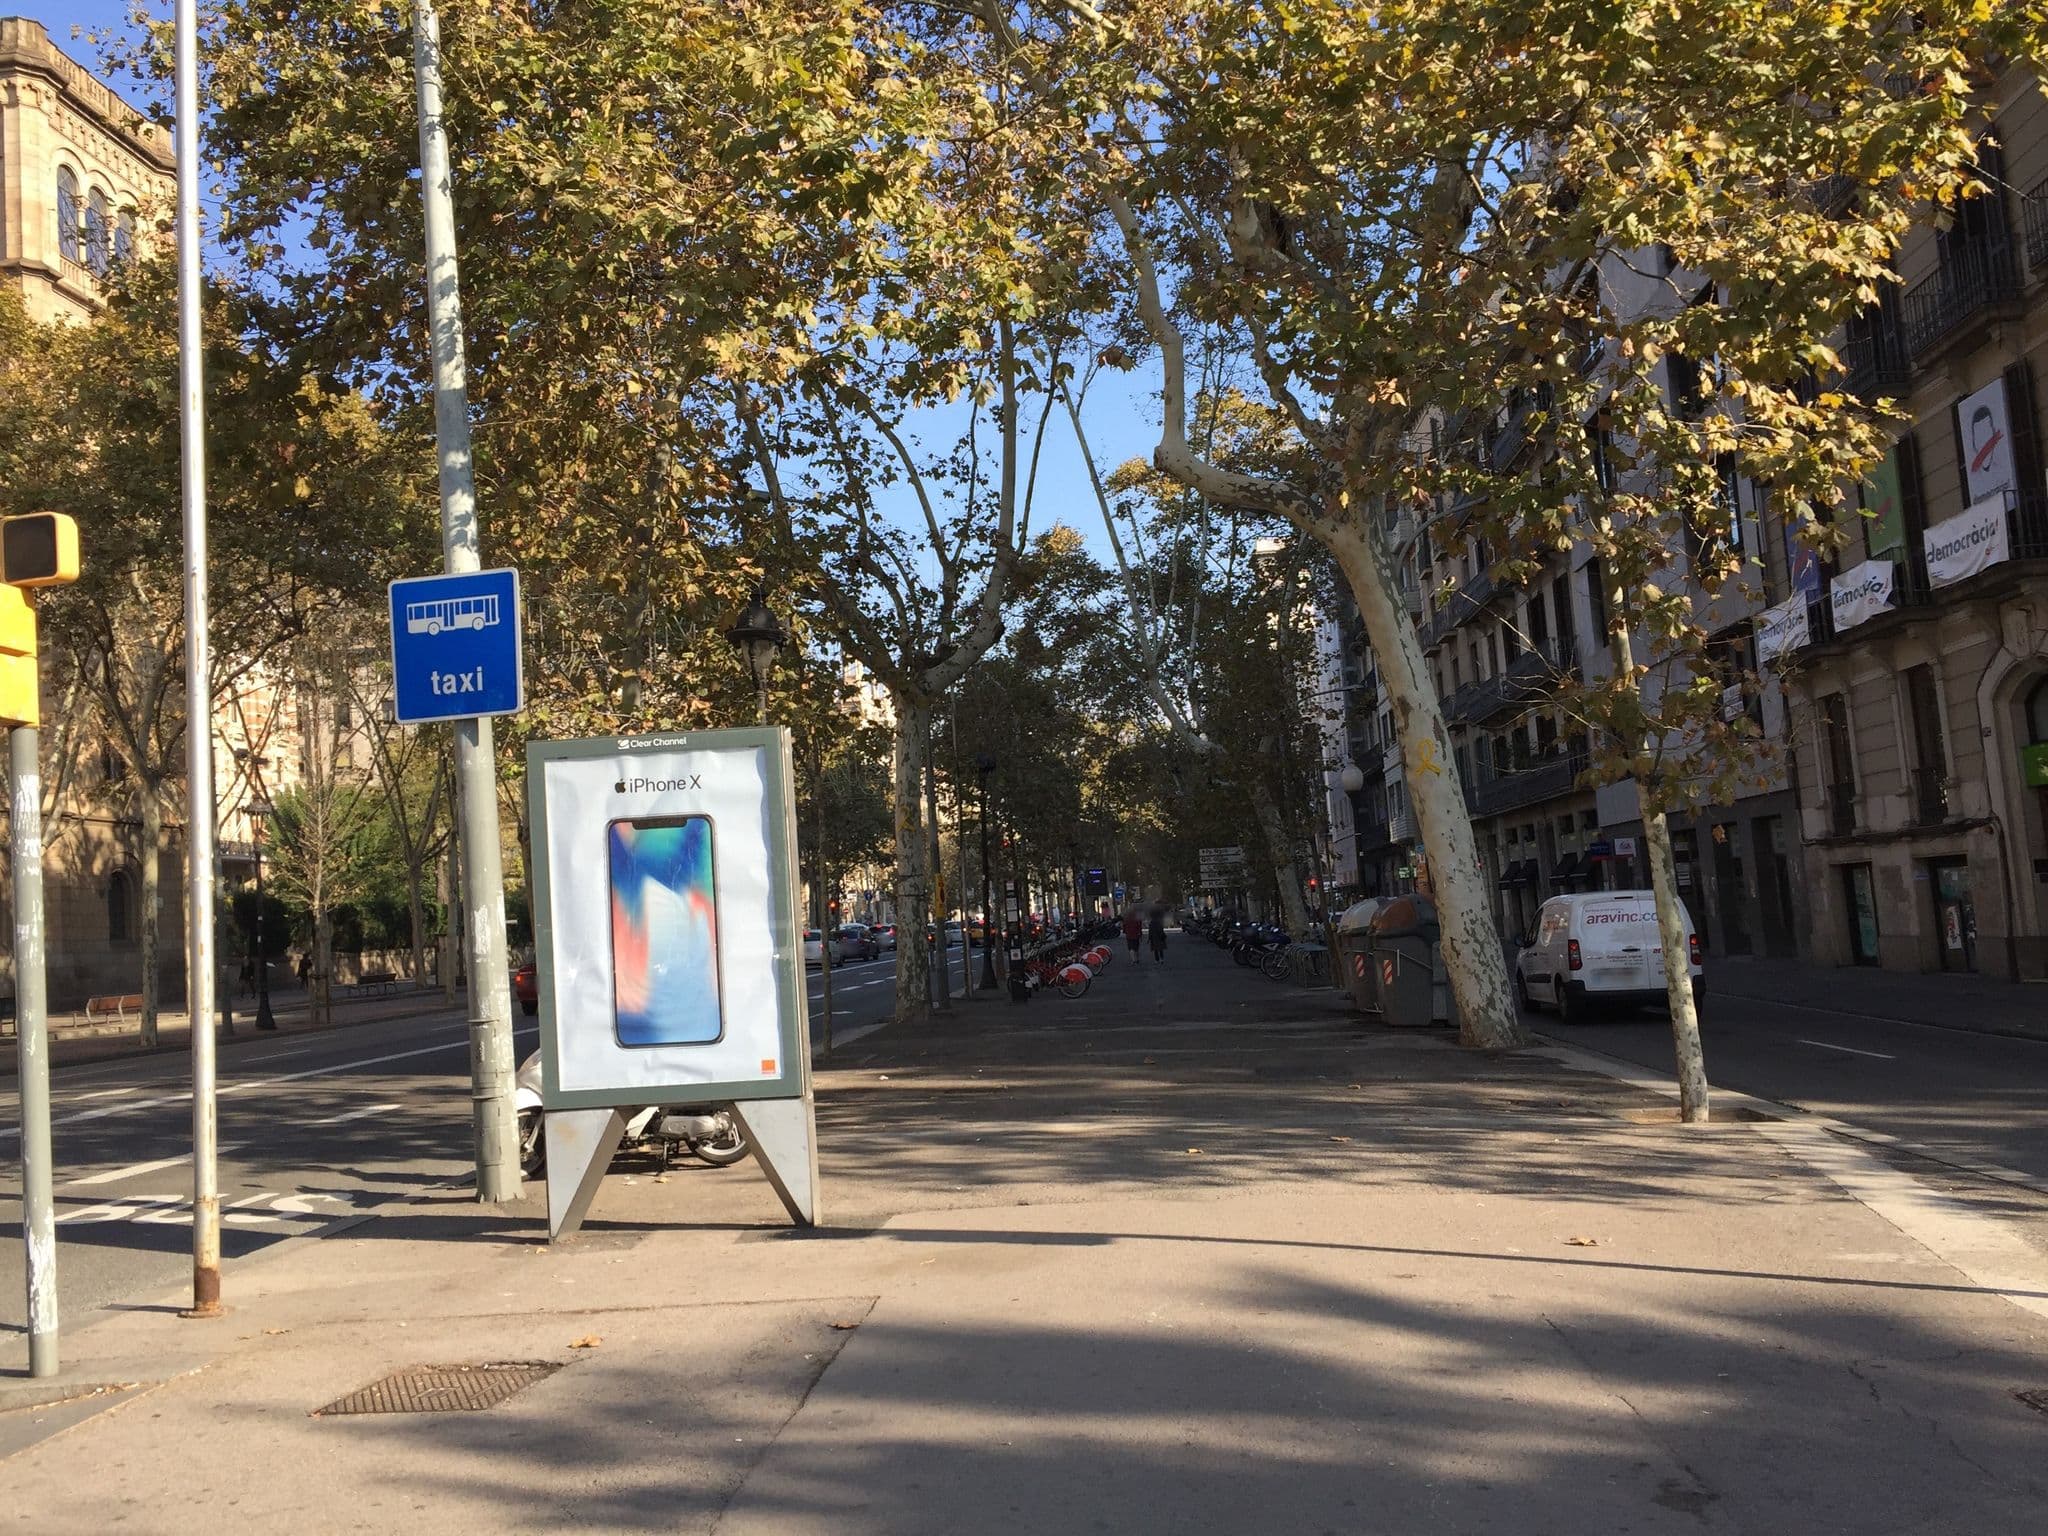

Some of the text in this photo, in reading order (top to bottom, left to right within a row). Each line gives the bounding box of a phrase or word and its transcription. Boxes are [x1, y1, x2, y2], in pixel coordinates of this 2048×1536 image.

[430, 666, 484, 695] taxi
[630, 736, 687, 748] Clear Channel
[629, 774, 702, 793] iPhone X
[1586, 911, 1659, 925] aravinc.co
